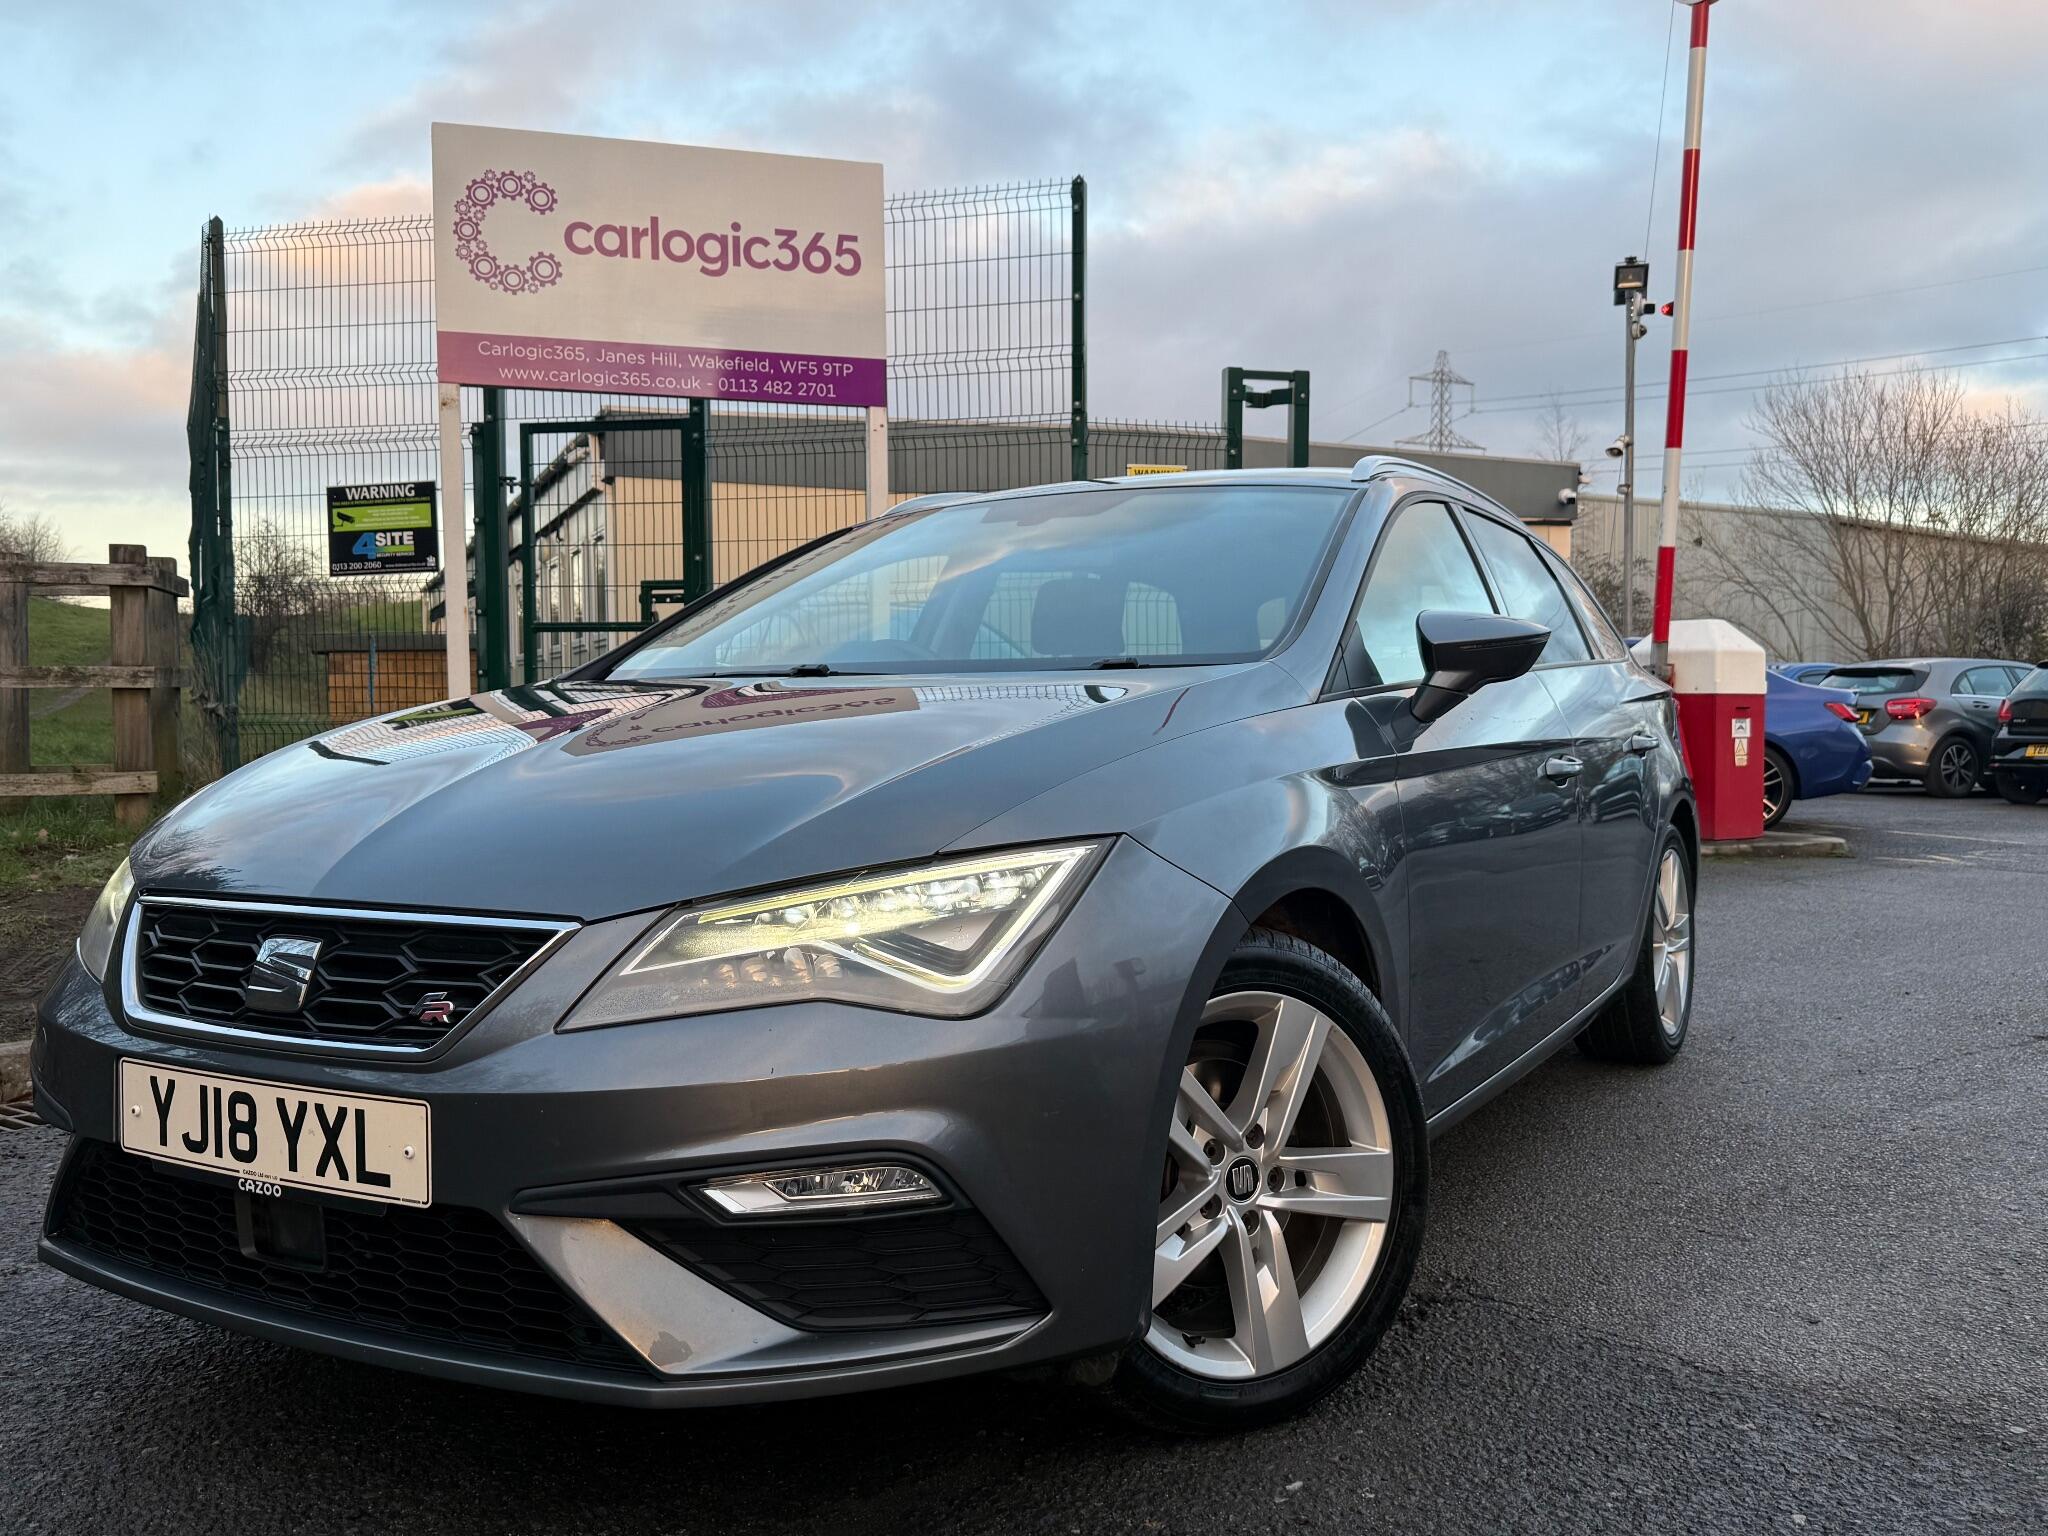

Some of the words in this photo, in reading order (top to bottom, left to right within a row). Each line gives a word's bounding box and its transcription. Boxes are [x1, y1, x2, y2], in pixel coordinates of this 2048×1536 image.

[564, 216, 861, 277] carlogic365
[478, 341, 590, 362] Carlogic365,
[597, 349, 645, 365] Janes
[652, 352, 682, 369] Hill,
[688, 354, 774, 374] Wakefield,
[780, 360, 818, 376] WF5
[823, 362, 854, 377] 9TP
[499, 367, 701, 389] www.carlogic365.co.uk
[719, 377, 758, 393] 0113
[763, 380, 793, 395] 482
[798, 383, 837, 398] 2701
[346, 484, 415, 500] WARNING
[349, 561, 363, 570] 200
[364, 561, 382, 570] 2060
[150, 1075, 258, 1164] YJ18
[275, 1097, 391, 1188] YXL
[238, 1178, 282, 1197] CAZOO
